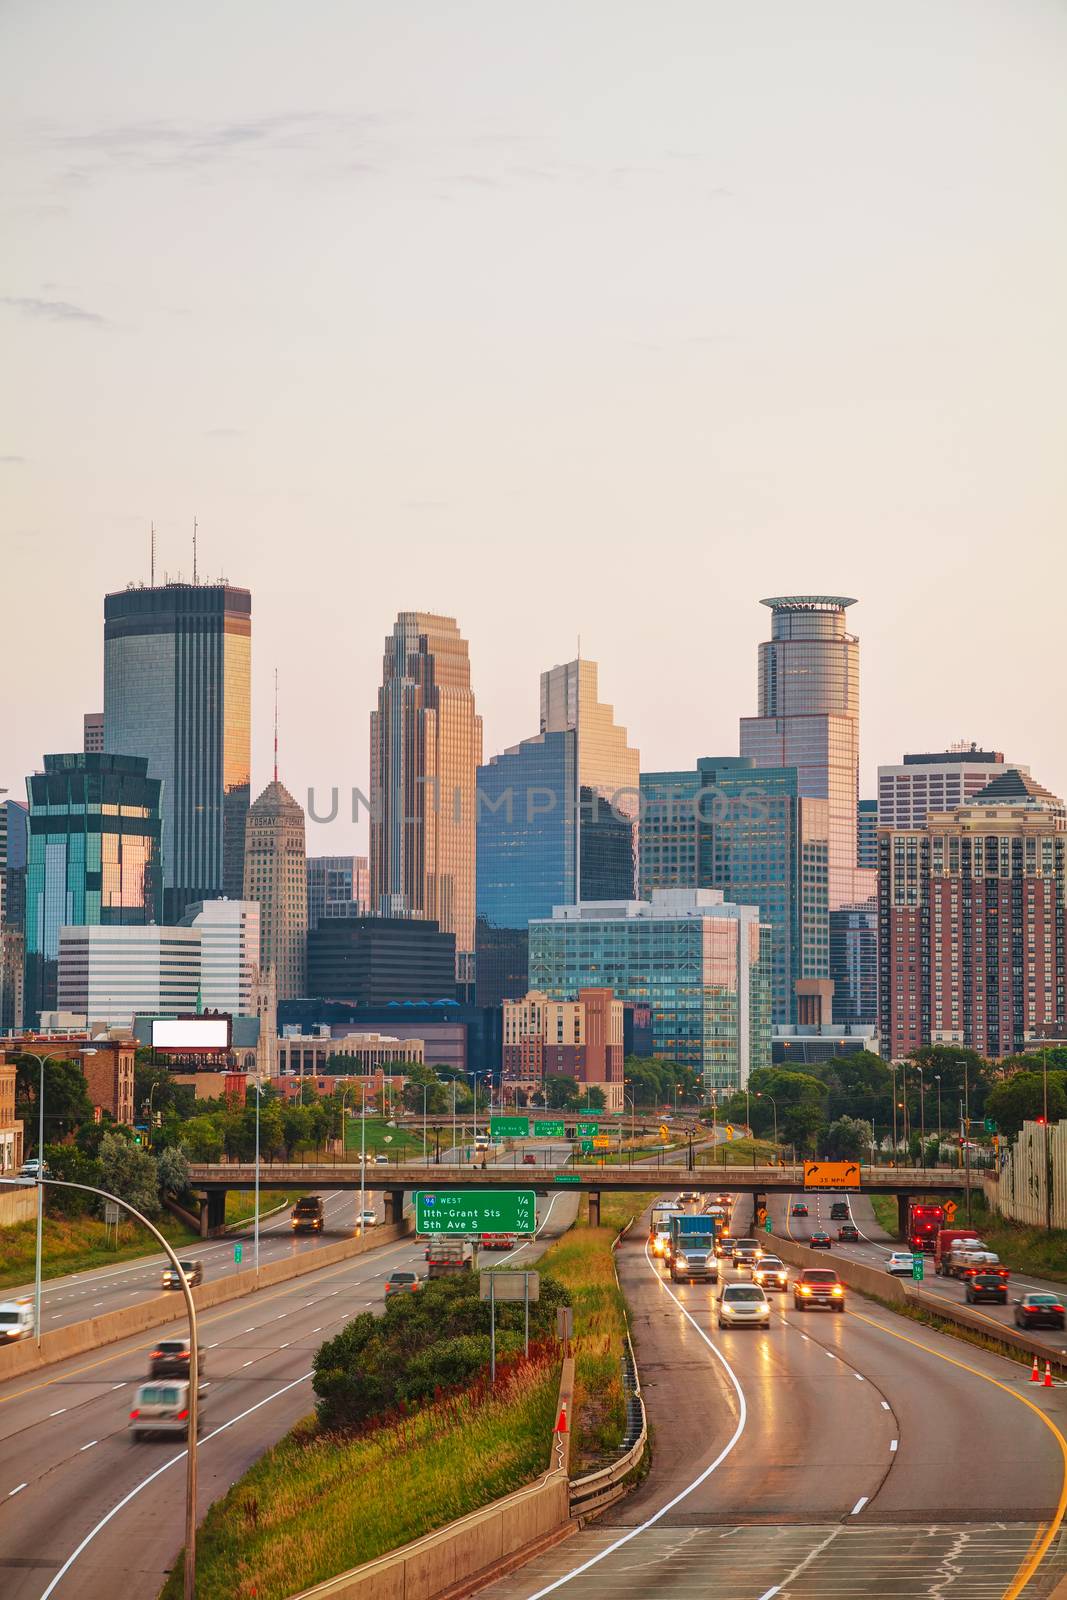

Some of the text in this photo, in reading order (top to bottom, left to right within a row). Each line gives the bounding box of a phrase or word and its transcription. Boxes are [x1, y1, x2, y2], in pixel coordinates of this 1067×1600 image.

[250, 817, 276, 826] FOSHAY
[423, 1209, 478, 1217] 11th-Grant
[484, 1209, 501, 1217] Sts
[423, 1220, 441, 1229] 5th
[447, 1220, 466, 1229] Ave
[471, 1220, 478, 1229] S
